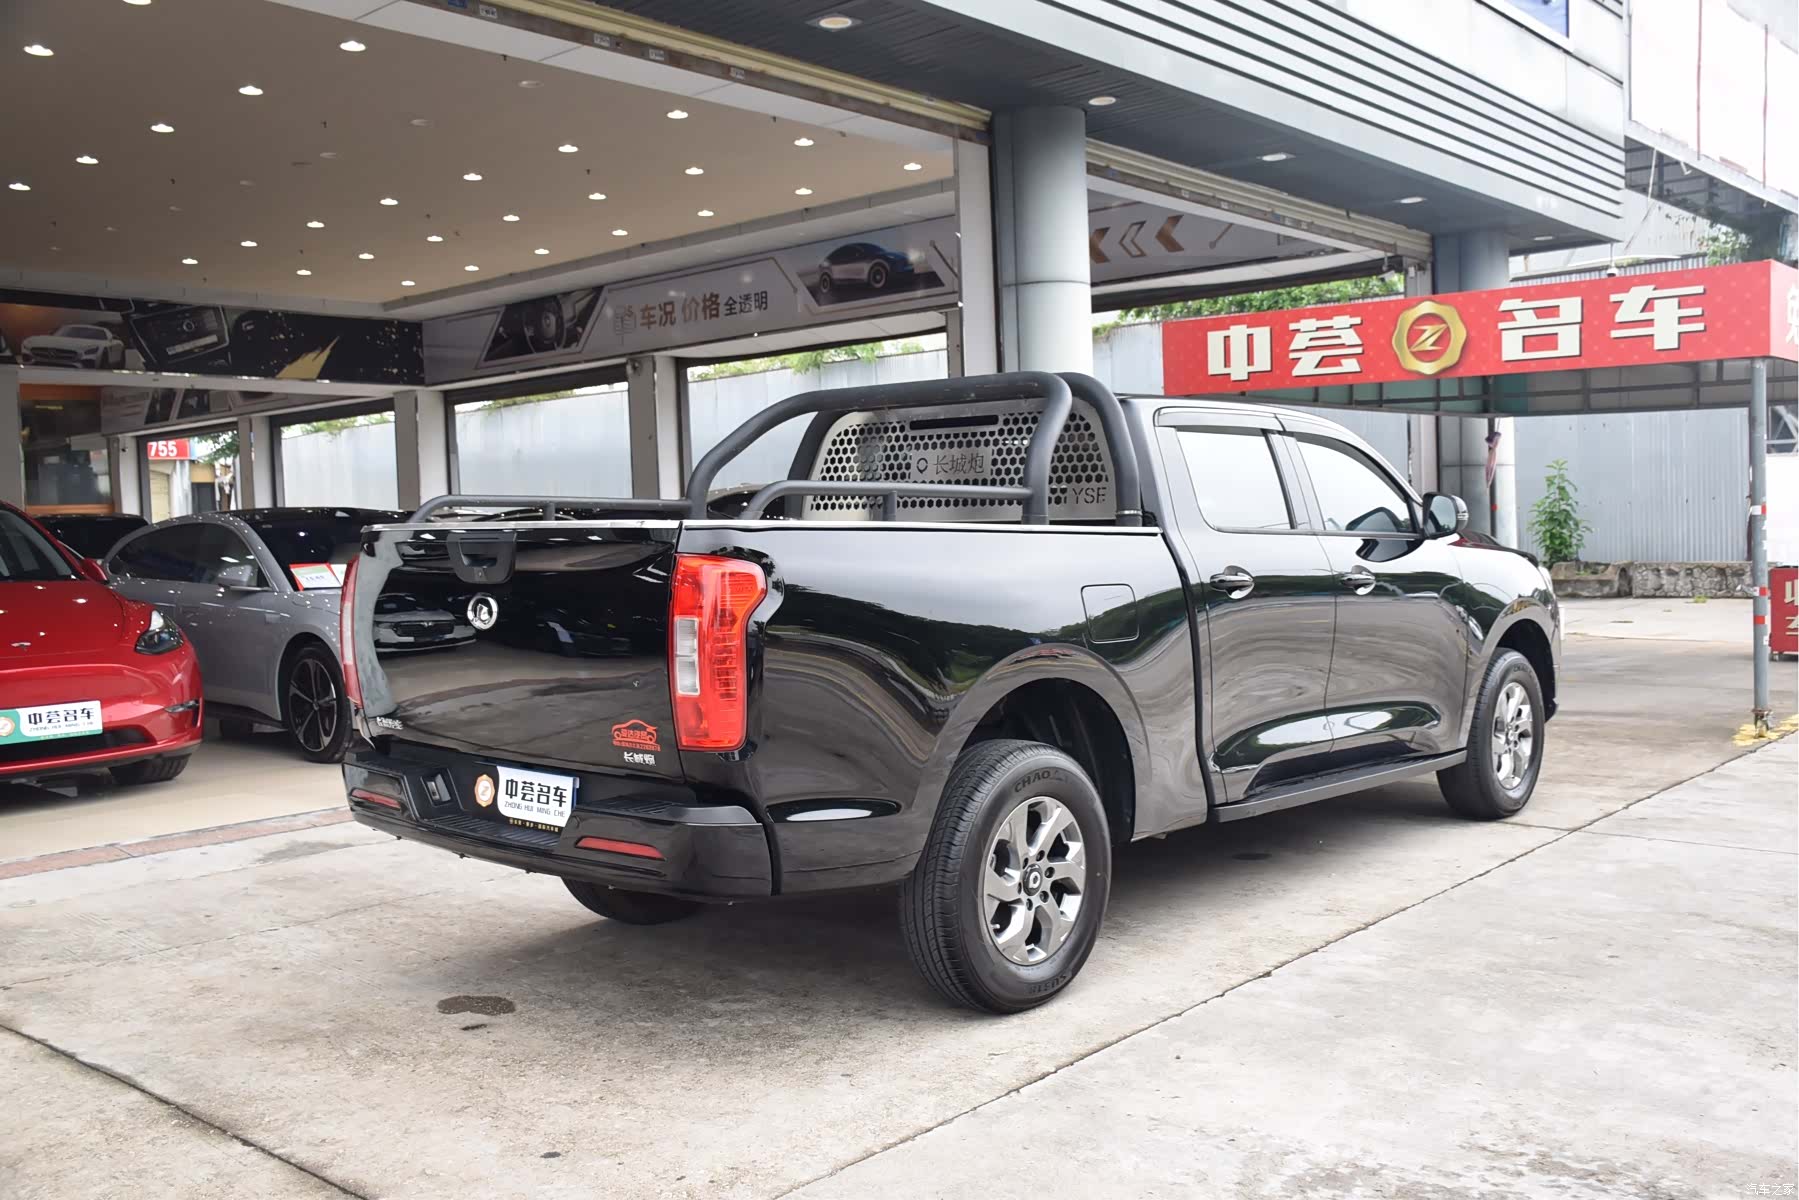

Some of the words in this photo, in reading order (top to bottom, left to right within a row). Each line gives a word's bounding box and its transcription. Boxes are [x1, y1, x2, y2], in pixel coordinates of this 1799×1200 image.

[640, 301, 676, 330] 车况
[682, 291, 721, 323] 价格
[724, 290, 769, 317] 全透明
[1498, 284, 1705, 361] 名车
[1207, 315, 1363, 382] 中荟
[148, 440, 178, 457] 755
[934, 453, 985, 475] 长城炮
[505, 778, 567, 808] 中荟名车
[504, 800, 523, 810] ZHONG
[524, 804, 534, 812] HUI
[537, 805, 551, 815] MING
[554, 809, 566, 818] CHE
